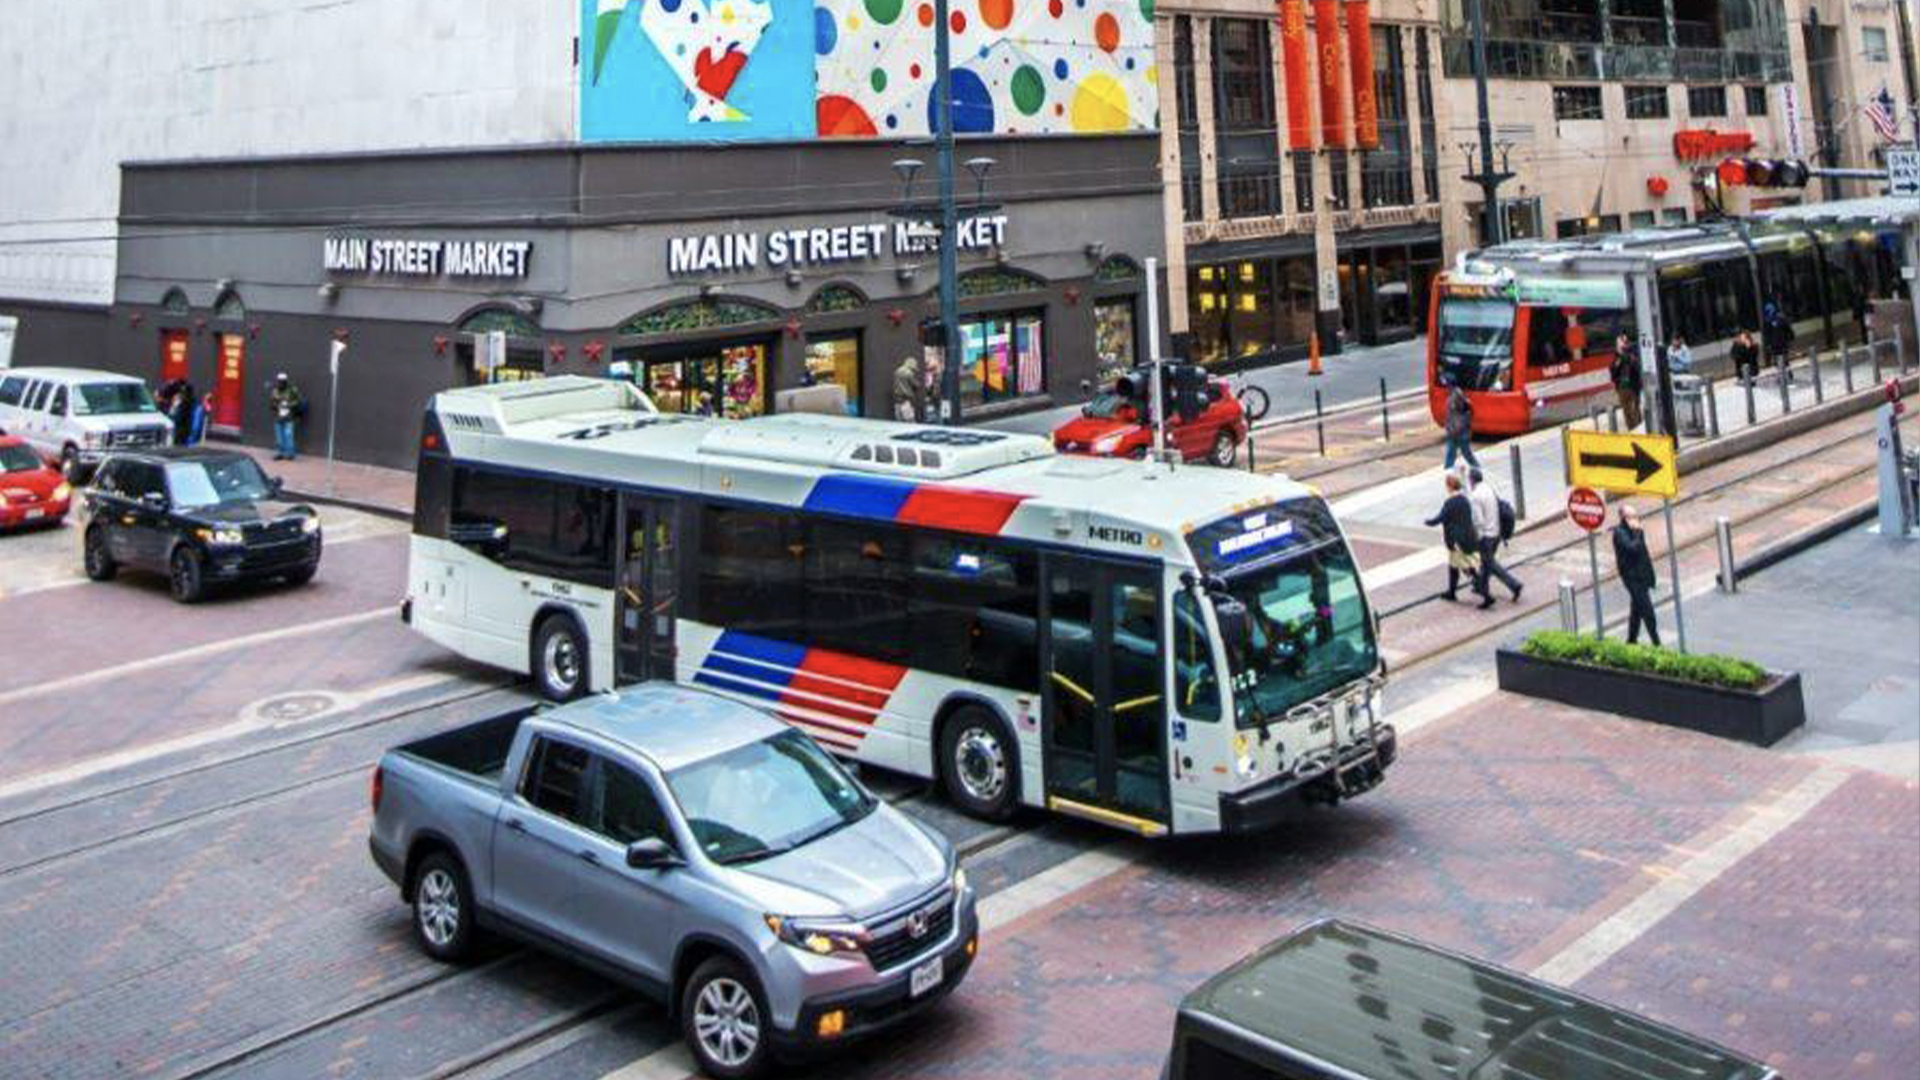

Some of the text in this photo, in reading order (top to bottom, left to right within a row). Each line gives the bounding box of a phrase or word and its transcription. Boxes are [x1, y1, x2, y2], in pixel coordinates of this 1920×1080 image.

[1891, 153, 1918, 166] ONE
[1892, 167, 1918, 178] WAY
[669, 215, 1008, 272] MAIN STREET MKET
[324, 238, 529, 276] MAIN STREET MARKET
[1088, 525, 1143, 545] METRO
